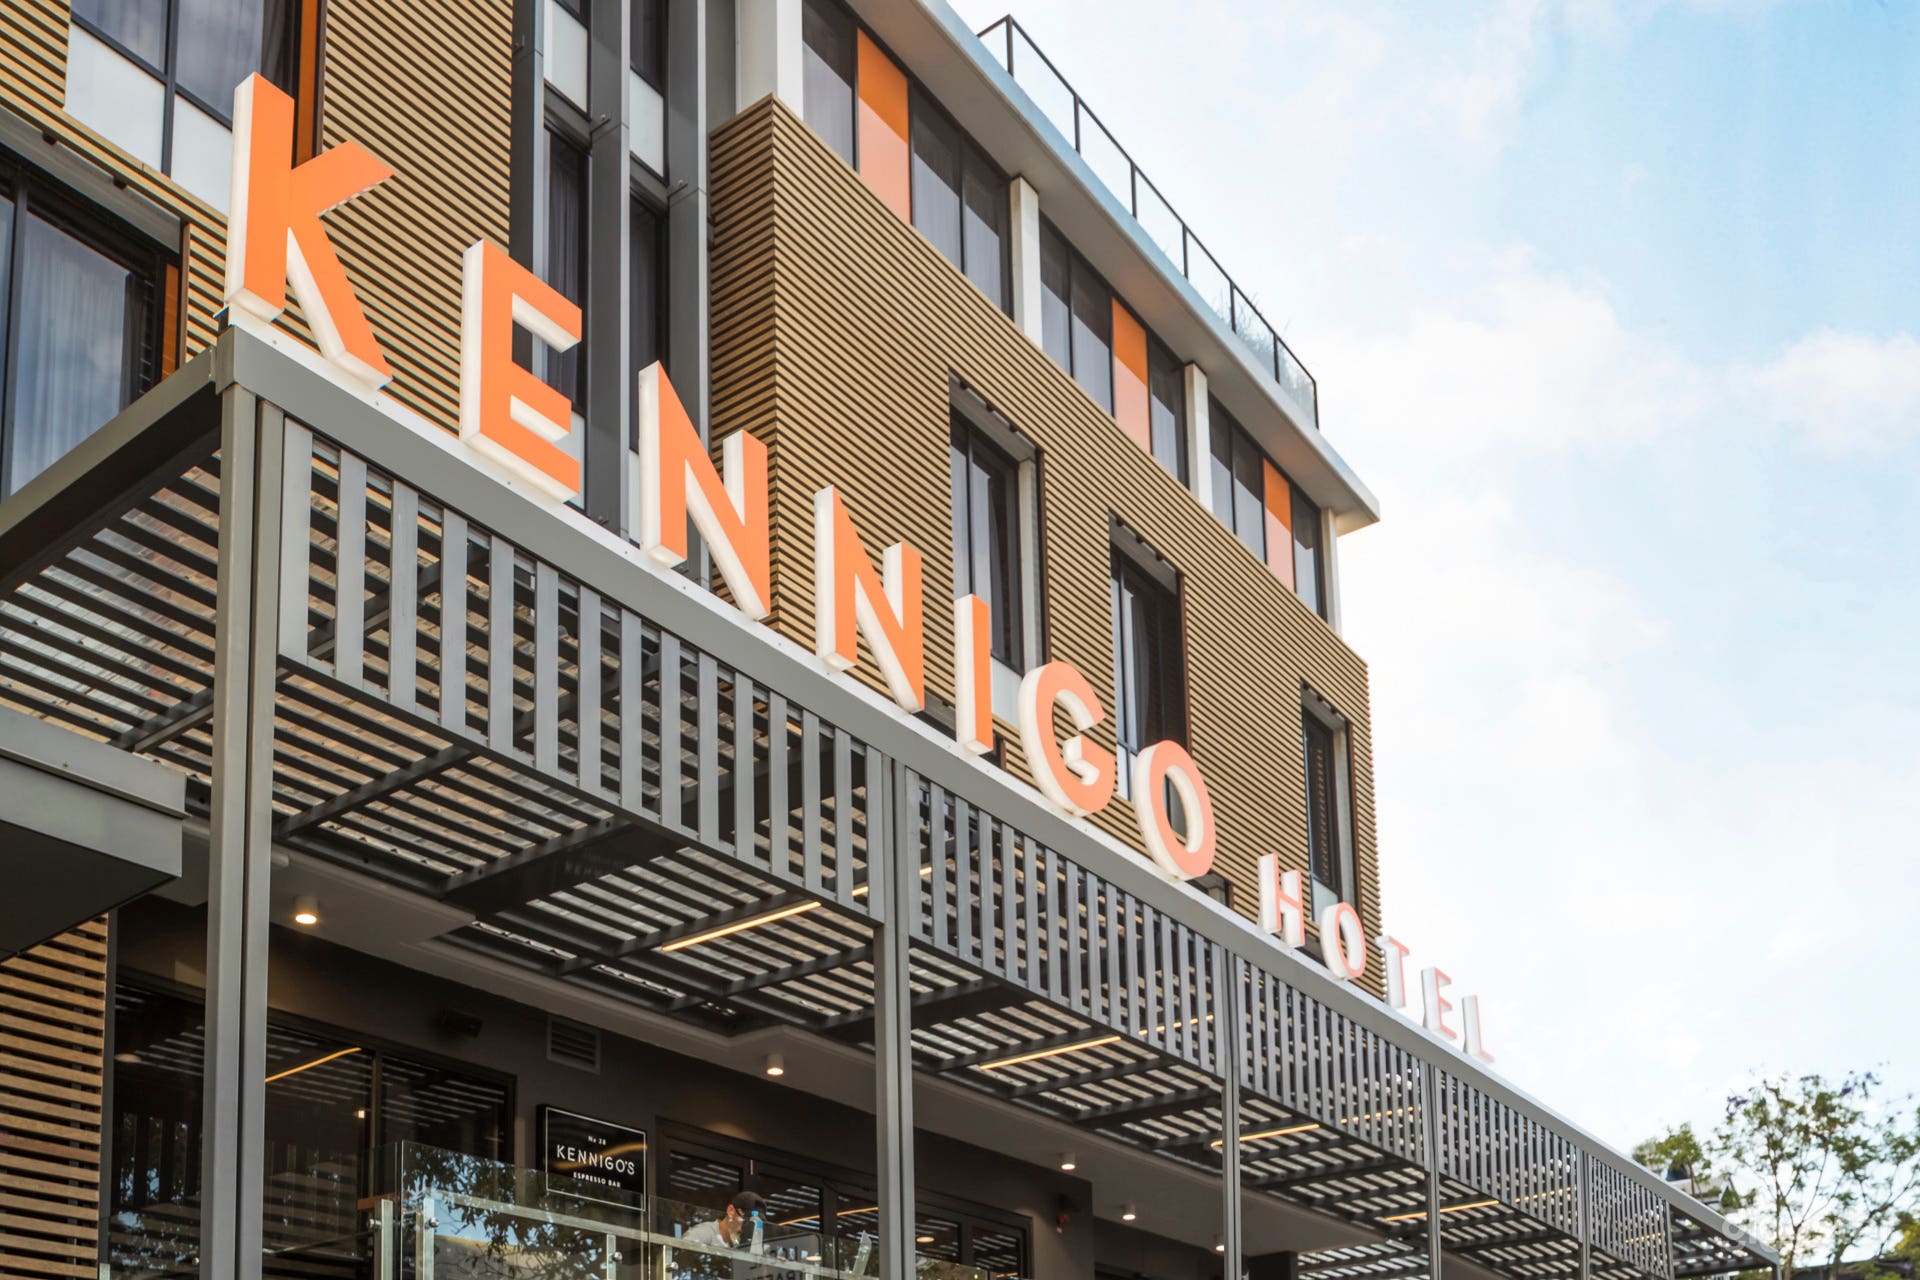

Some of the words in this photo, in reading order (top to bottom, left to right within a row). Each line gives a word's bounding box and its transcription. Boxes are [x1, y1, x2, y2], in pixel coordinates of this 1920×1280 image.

[225, 72, 1216, 880] KENNIGO
[1258, 852, 1494, 1064] HOTEL
[556, 1144, 635, 1175] KENNIGO'S
[573, 1171, 606, 1185] ESPRESSO
[608, 1180, 621, 1188] BAR
